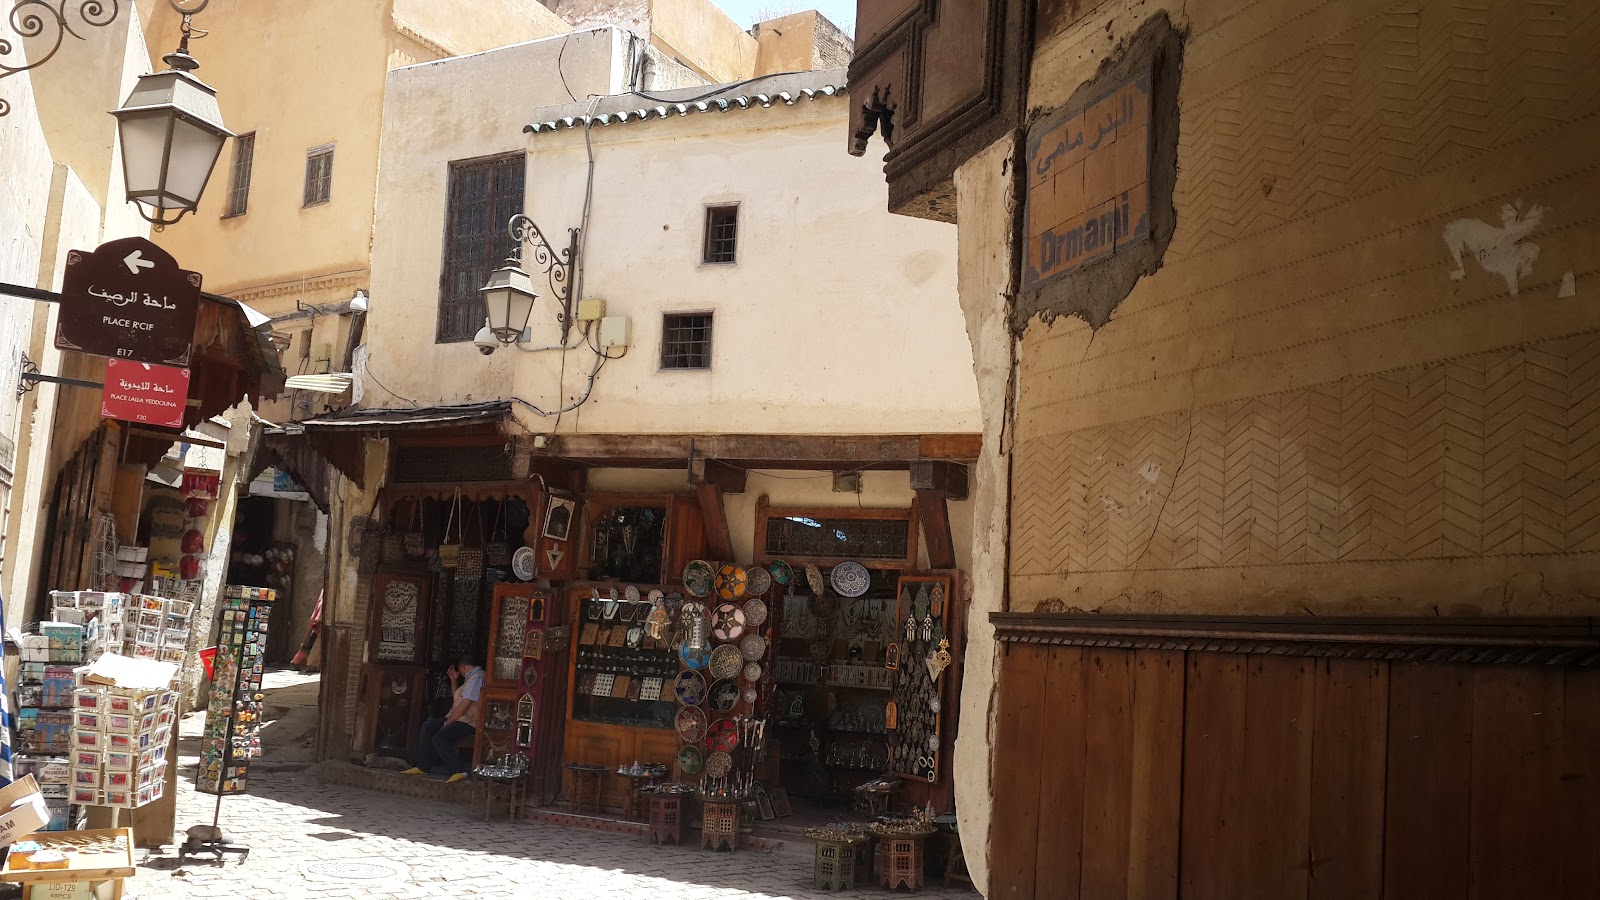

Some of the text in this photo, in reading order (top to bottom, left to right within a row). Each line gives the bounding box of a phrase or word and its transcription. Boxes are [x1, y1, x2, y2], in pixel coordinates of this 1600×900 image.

[88, 285, 176, 309] ساحة الرصيف
[102, 316, 154, 331] PLACE R'CIF
[116, 348, 133, 357] E17
[153, 383, 174, 394] ساحة
[110, 393, 127, 401] PLACE
[145, 398, 177, 408] YEDDOUNA
